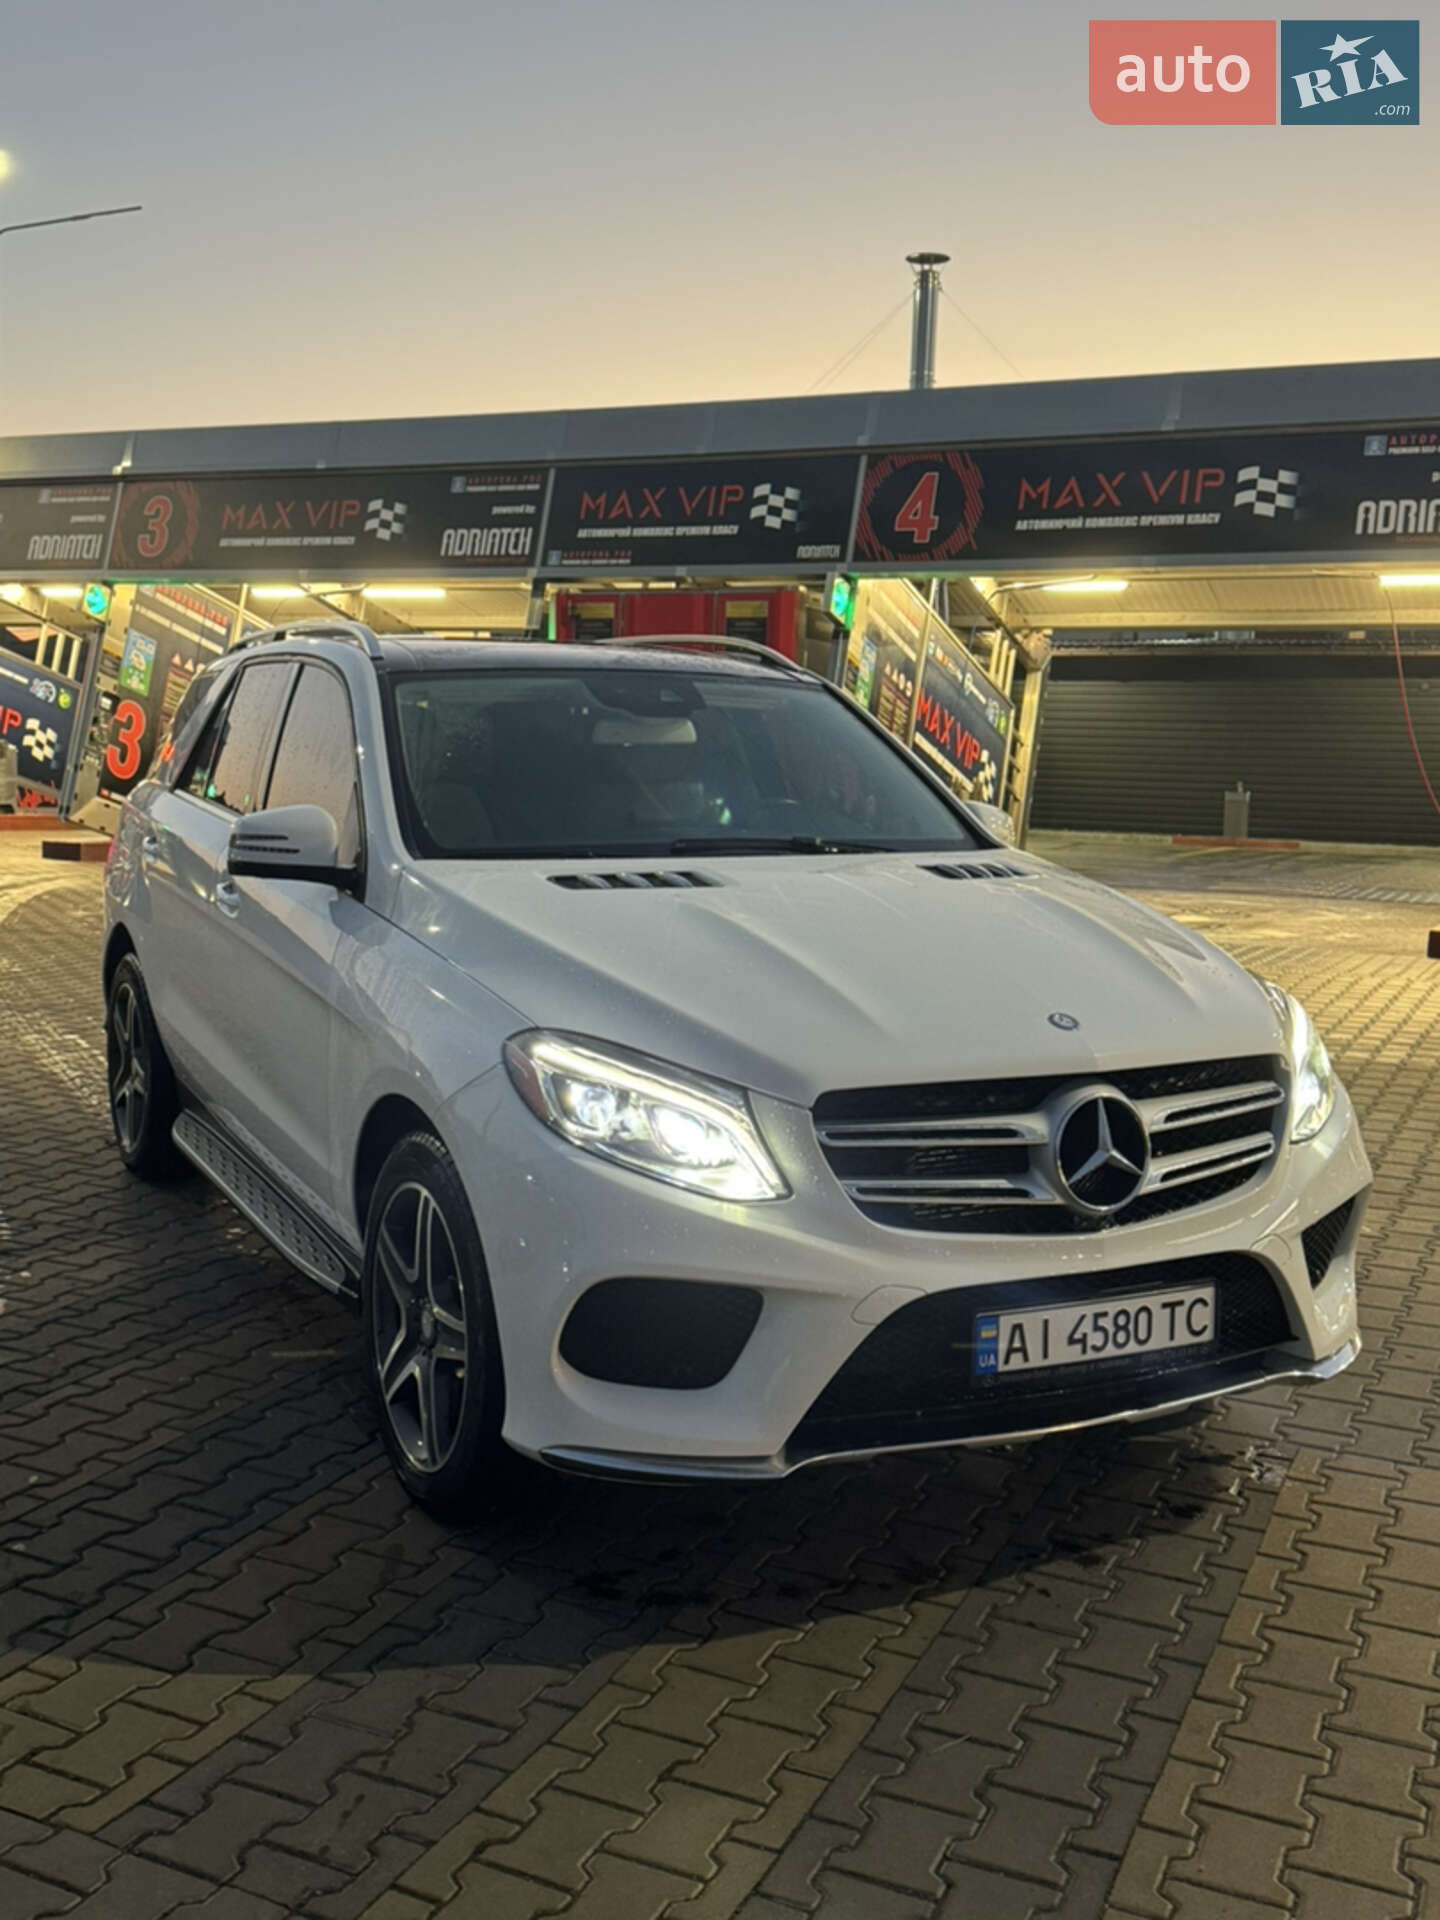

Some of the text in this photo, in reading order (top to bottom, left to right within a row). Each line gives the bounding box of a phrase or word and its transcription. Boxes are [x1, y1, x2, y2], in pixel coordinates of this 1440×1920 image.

[221, 500, 361, 530] MAX VIP
[579, 485, 744, 520] MAX VIP
[894, 472, 939, 544] 4
[1017, 468, 1225, 510] MAX VIP
[137, 495, 173, 557] 3
[107, 699, 146, 779] 3
[916, 686, 955, 751] MAX
[956, 721, 980, 770] VIP
[979, 1354, 996, 1367] UA
[1003, 1296, 1210, 1365] AI 4580 TC
